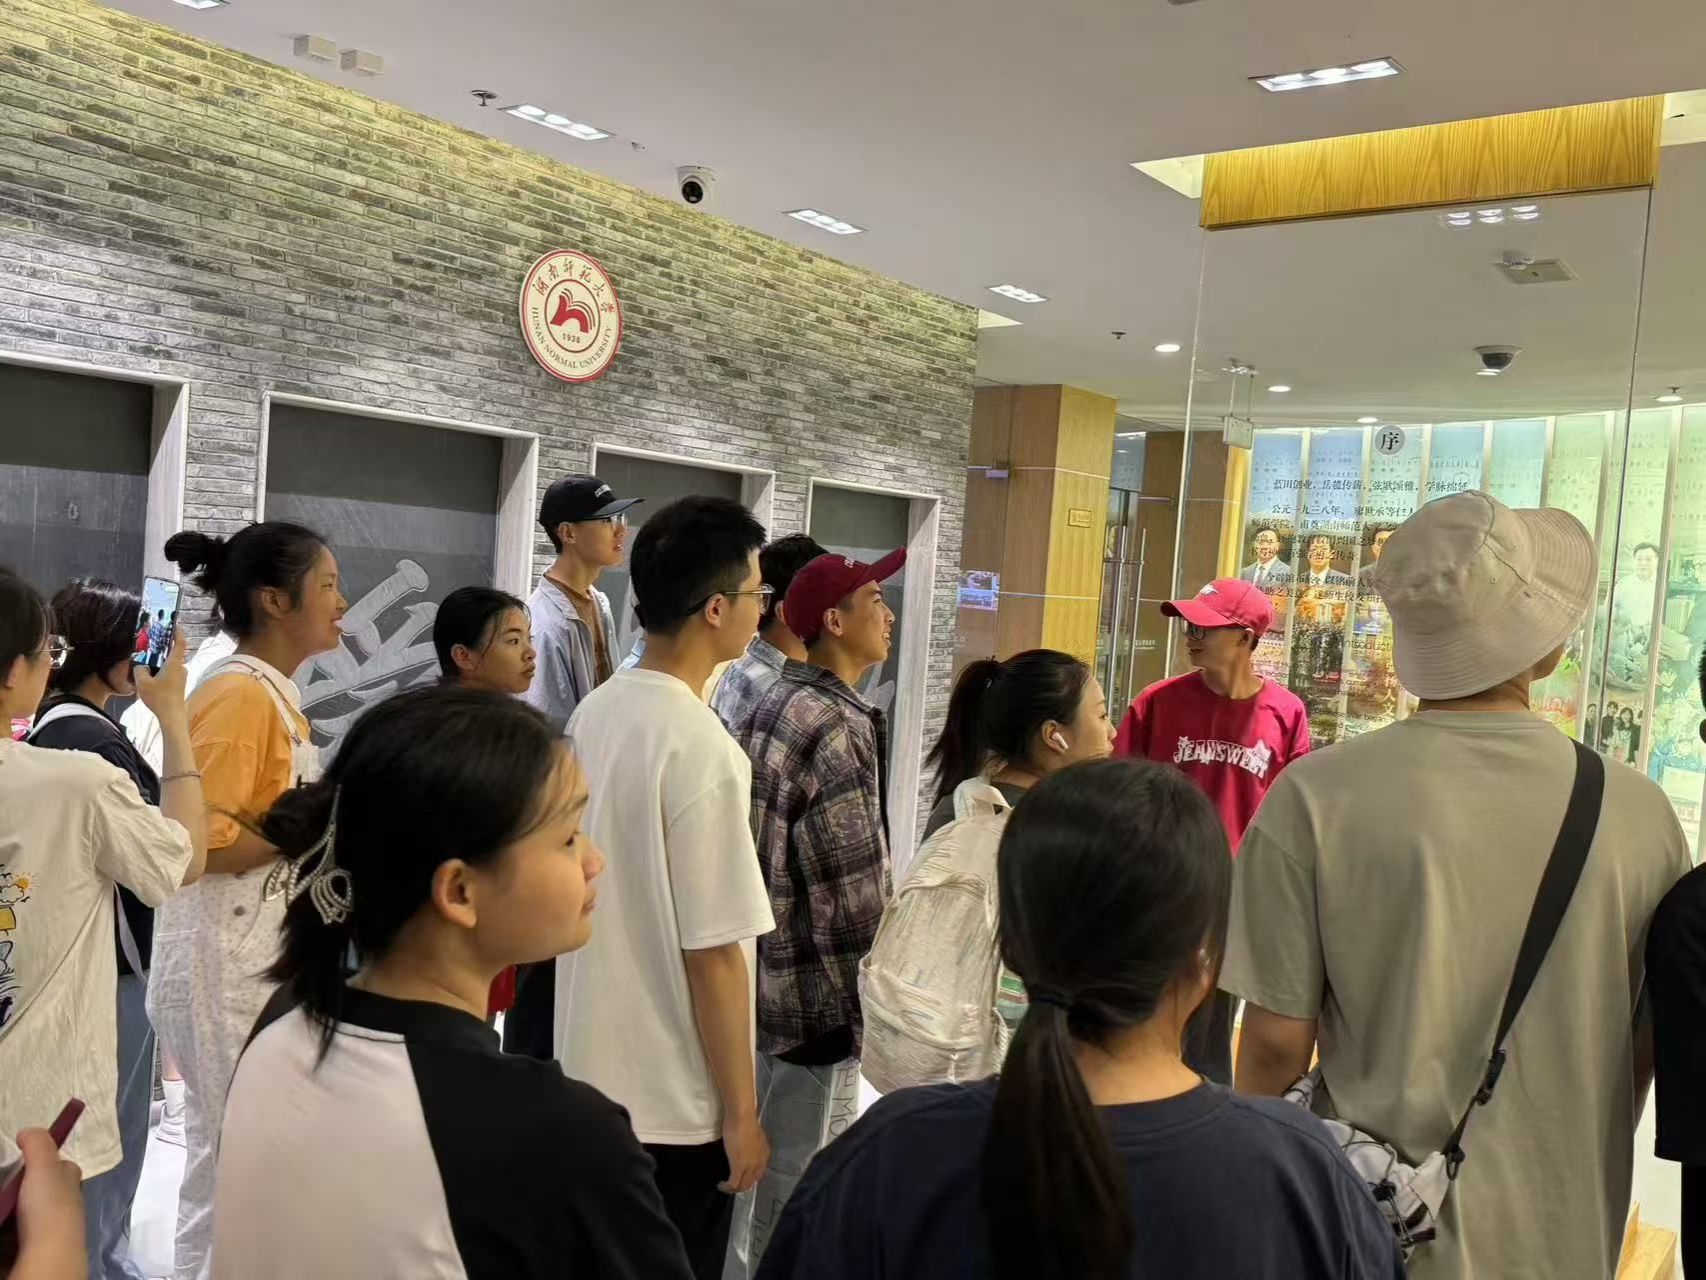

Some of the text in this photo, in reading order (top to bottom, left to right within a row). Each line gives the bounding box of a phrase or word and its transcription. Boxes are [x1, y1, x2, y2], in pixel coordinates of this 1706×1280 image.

[532, 306, 612, 369] HUNAN NORMAL UNIVERSITY
[562, 333, 581, 344] 1938
[1380, 432, 1400, 451] 序
